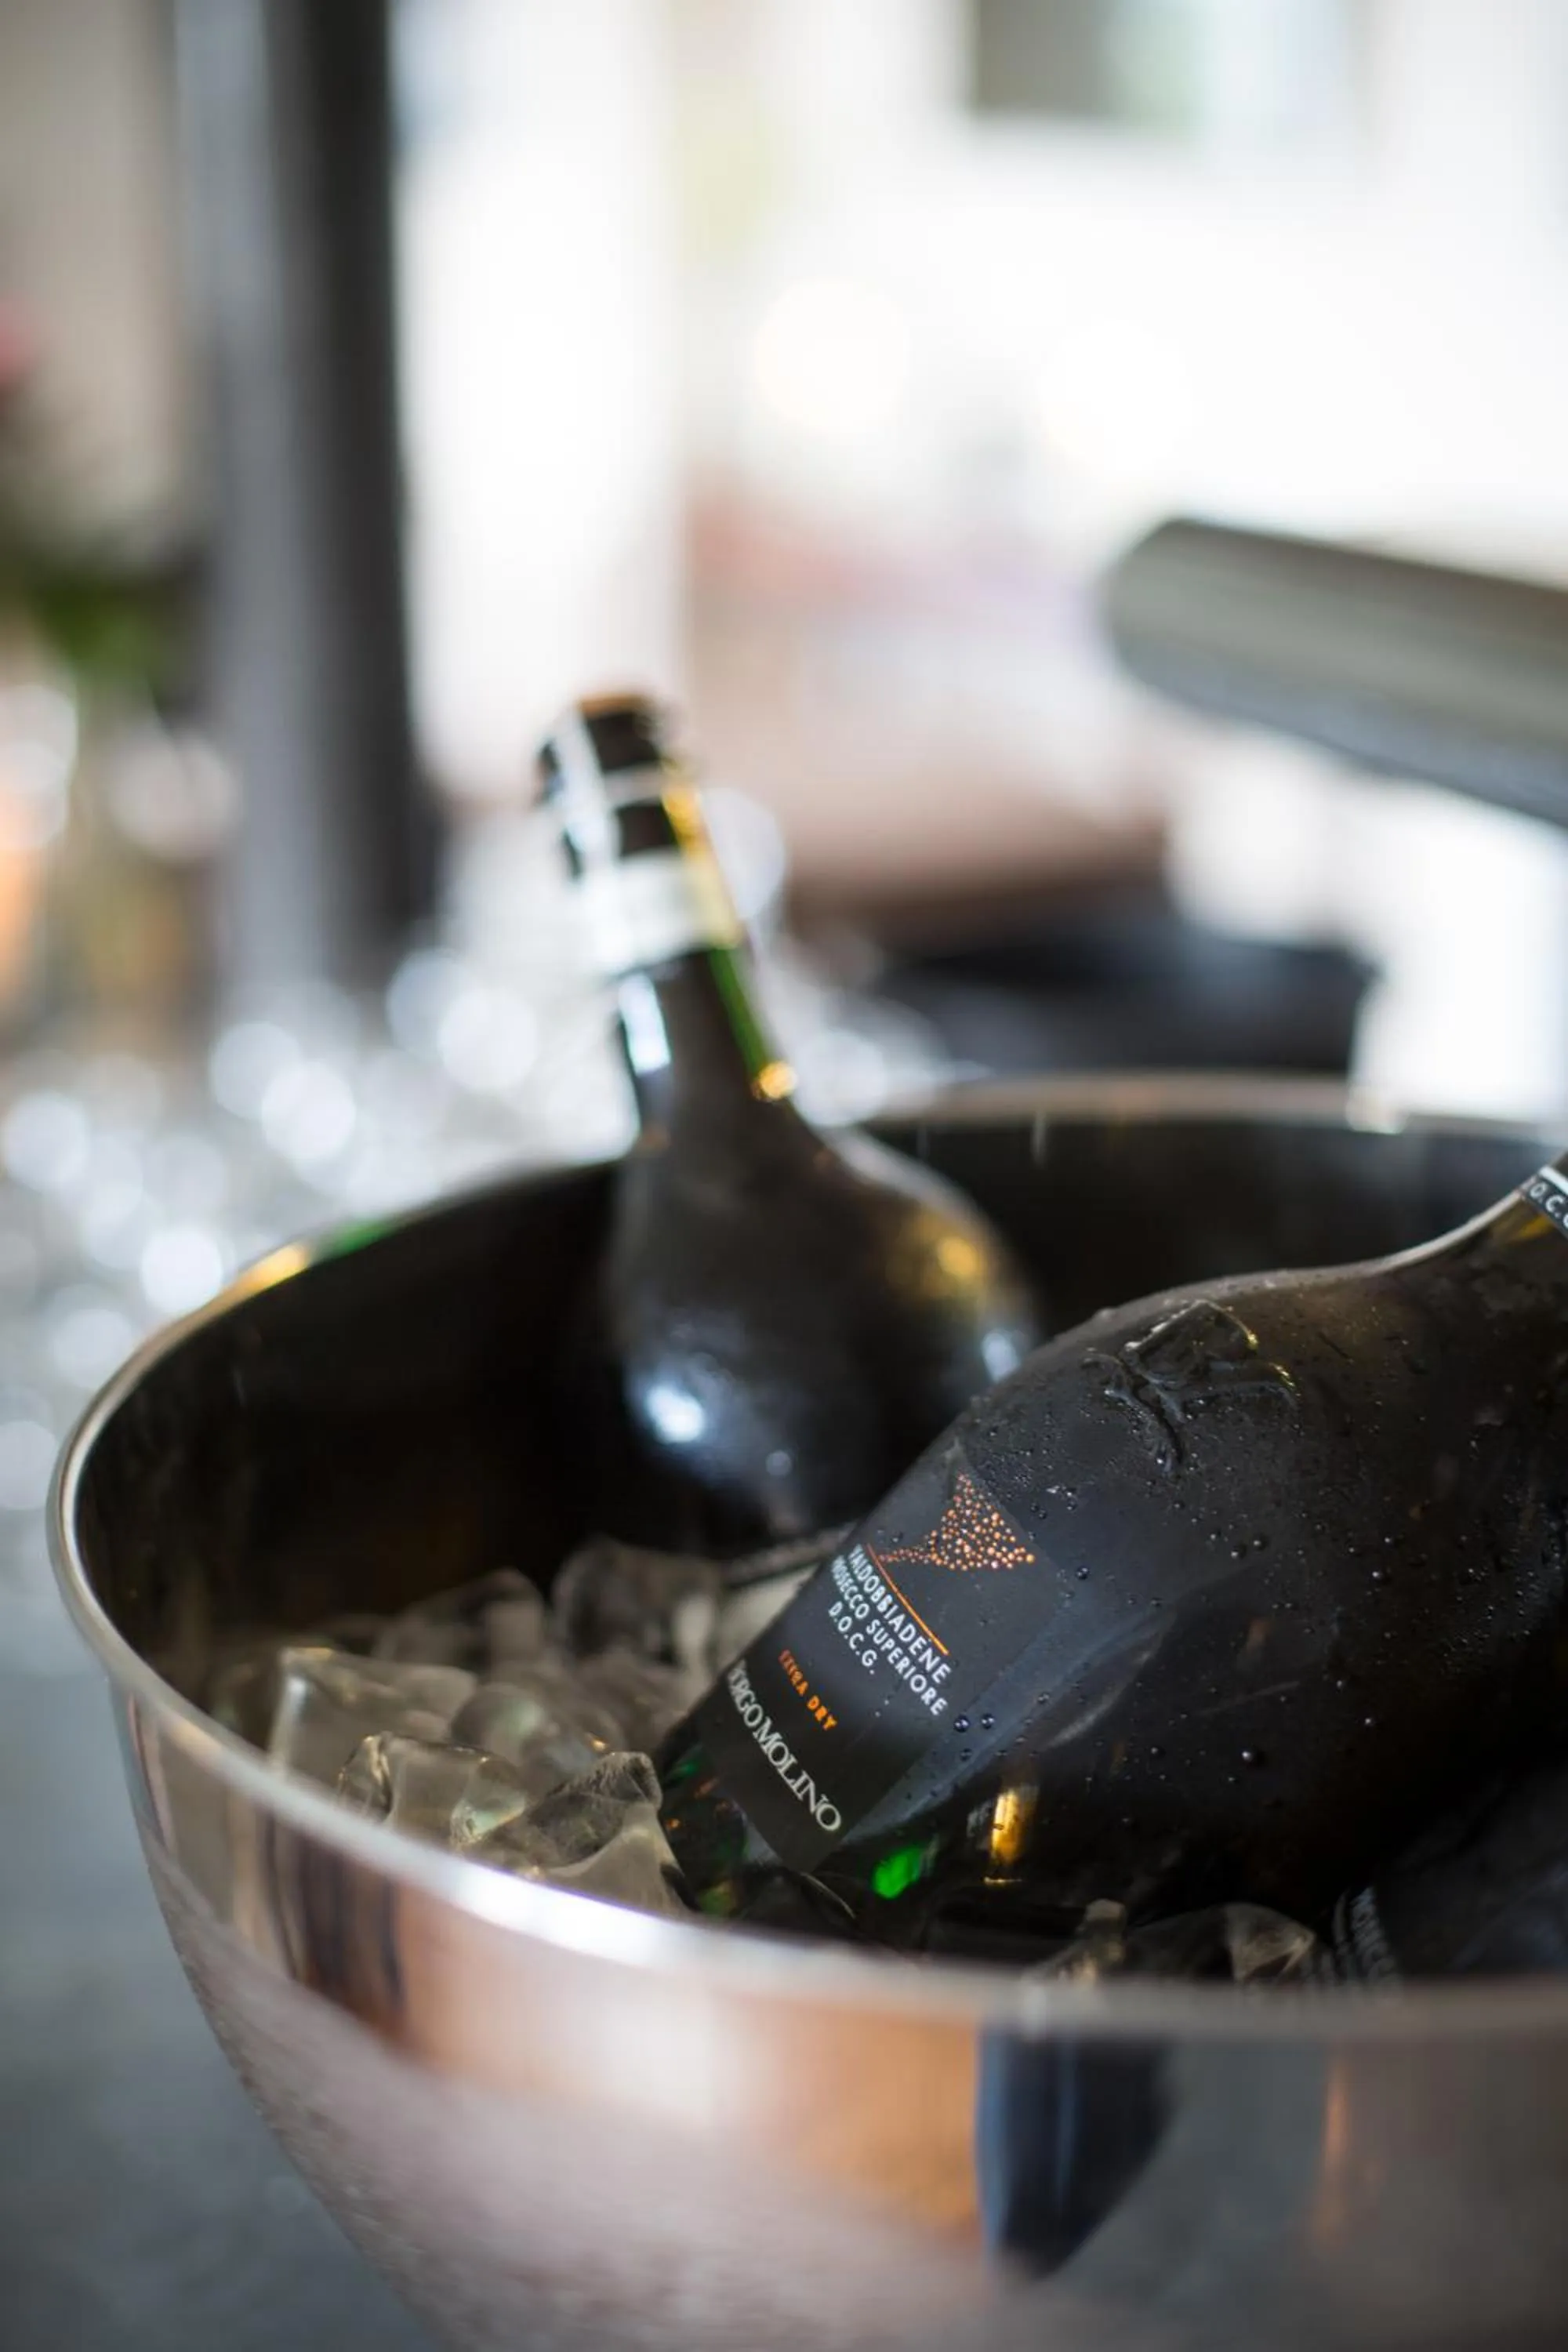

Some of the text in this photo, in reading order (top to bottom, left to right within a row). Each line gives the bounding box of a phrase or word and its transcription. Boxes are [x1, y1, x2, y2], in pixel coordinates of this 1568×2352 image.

[828, 1601, 878, 1675] D.O.C.G.
[848, 1544, 952, 1684] VALDOBBIADENE
[866, 1619, 948, 1716] SUPERIORE
